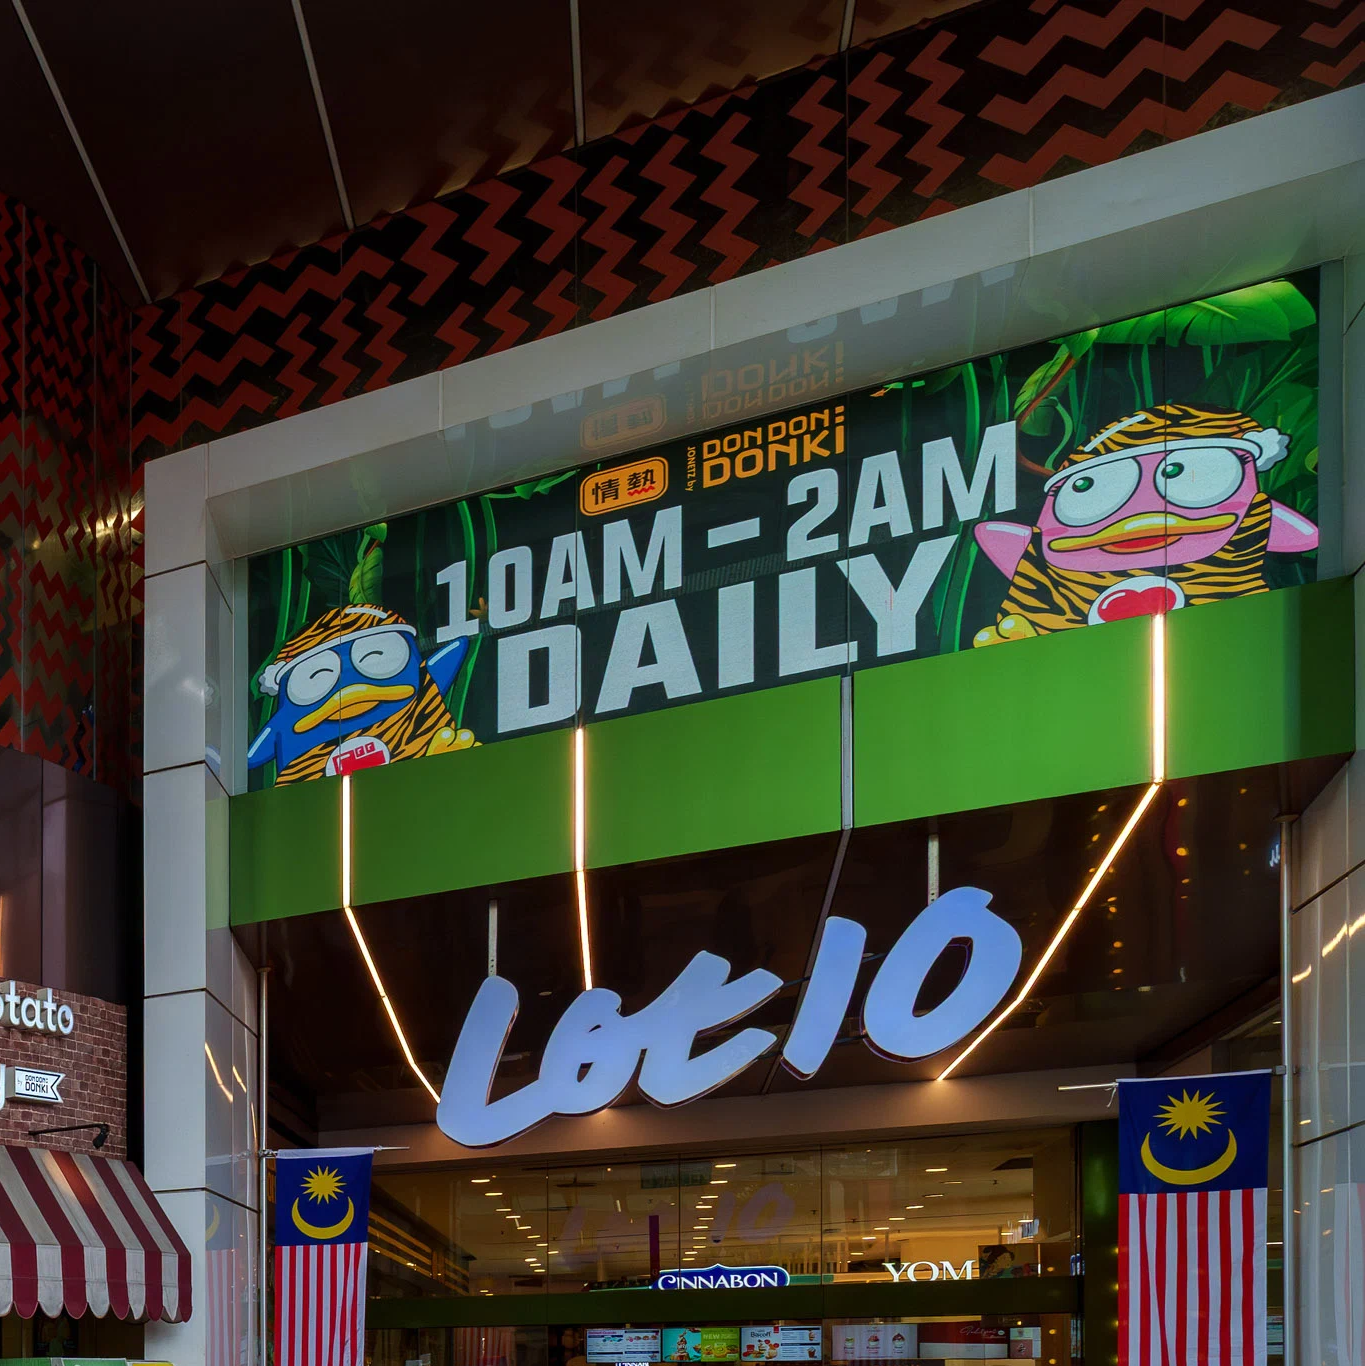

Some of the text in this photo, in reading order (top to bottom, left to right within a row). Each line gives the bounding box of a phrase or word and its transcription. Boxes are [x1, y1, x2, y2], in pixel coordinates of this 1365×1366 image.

[702, 408, 827, 460] DON DON
[685, 445, 697, 480] JONETZ
[590, 472, 658, 507] 情熱
[436, 420, 1018, 644] 10AM 2AM
[497, 533, 959, 735] DAILY
[657, 1271, 779, 1290] CINNABON
[882, 1259, 977, 1283] YOM
